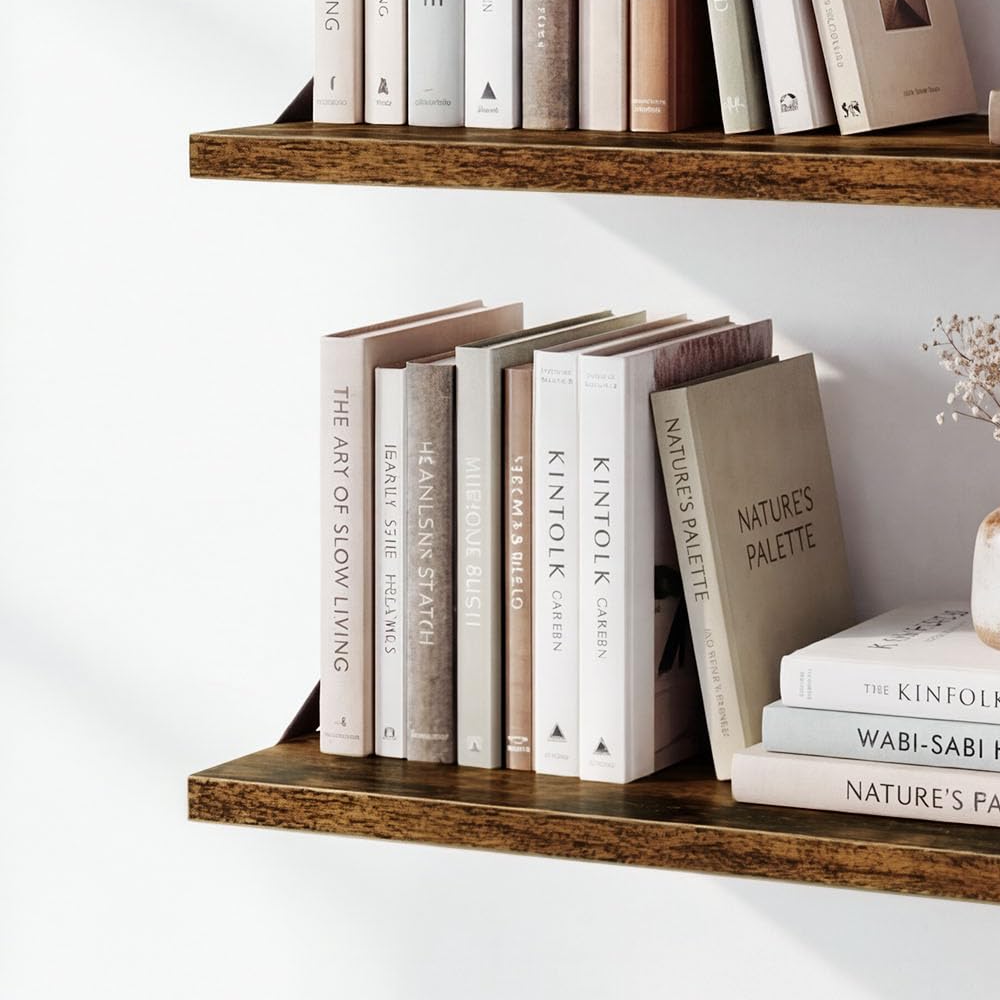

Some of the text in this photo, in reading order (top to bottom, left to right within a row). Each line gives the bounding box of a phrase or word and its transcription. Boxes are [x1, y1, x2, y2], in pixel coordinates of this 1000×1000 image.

[333, 387, 349, 426] THE
[333, 486, 349, 514] OF
[664, 418, 710, 602] NATURE'S PALETTE
[737, 487, 814, 534] NATURE'S
[333, 524, 349, 588] SLOW
[746, 524, 816, 570] PALETTE
[333, 597, 349, 672] LIVING
[857, 728, 983, 759] WABI-SABI
[847, 779, 963, 810] NATURE'S
